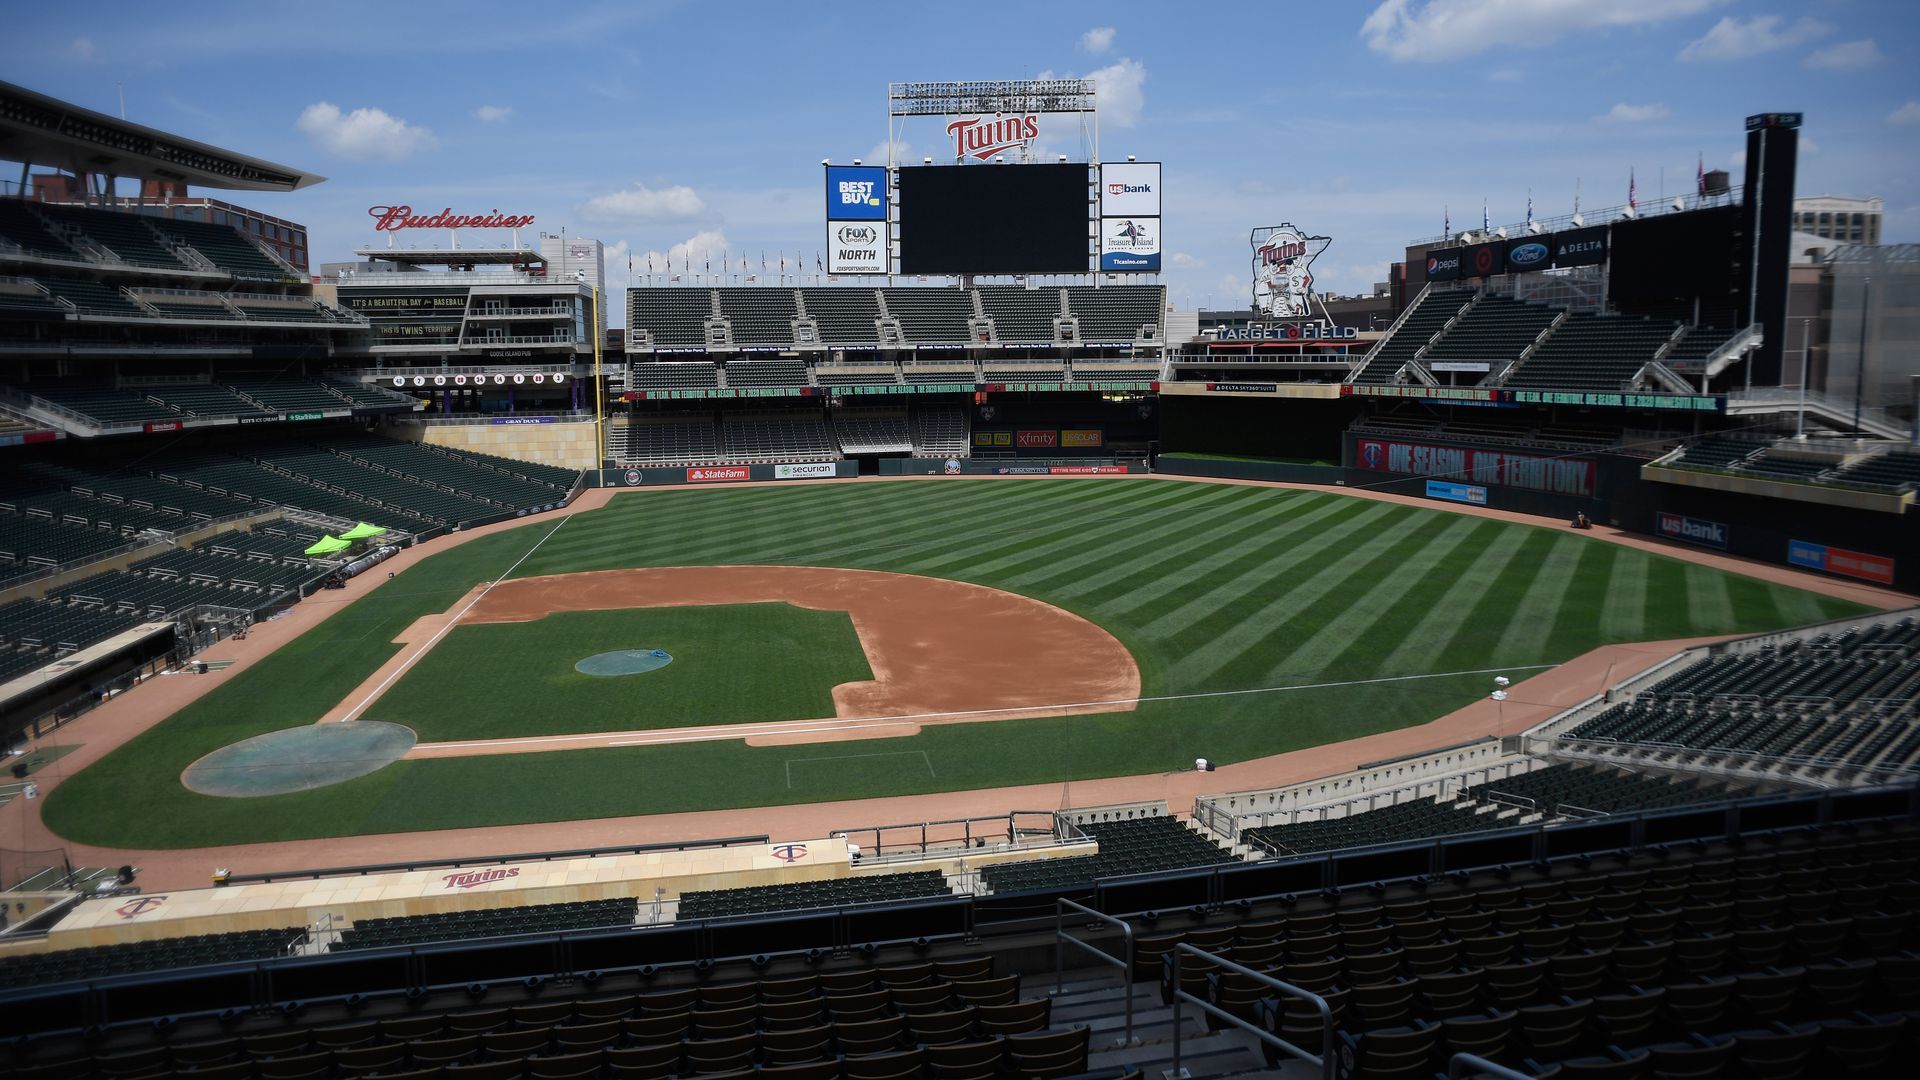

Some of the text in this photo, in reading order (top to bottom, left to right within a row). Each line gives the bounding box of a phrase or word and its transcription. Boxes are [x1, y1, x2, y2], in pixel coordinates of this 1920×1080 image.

[946, 111, 1039, 160] Twins
[839, 182, 874, 192] BEST
[842, 192, 872, 204] BUY
[368, 206, 535, 232] Budweiser
[846, 228, 868, 238] FOX
[1108, 237, 1154, 246] Treasure Island
[1569, 241, 1602, 252] DELTA
[838, 250, 876, 260] NORTH
[1258, 240, 1307, 267] Twins
[1517, 250, 1543, 261] Ford
[1438, 257, 1459, 271] pepsi
[400, 326, 423, 335] TWINS
[1217, 327, 1356, 339] TARGET FIELD
[1020, 433, 1054, 445] xfinity
[792, 465, 830, 473] securian
[1388, 444, 1590, 495] ONE SEASON. ONE TERRITORY.
[442, 868, 520, 889] Twins
